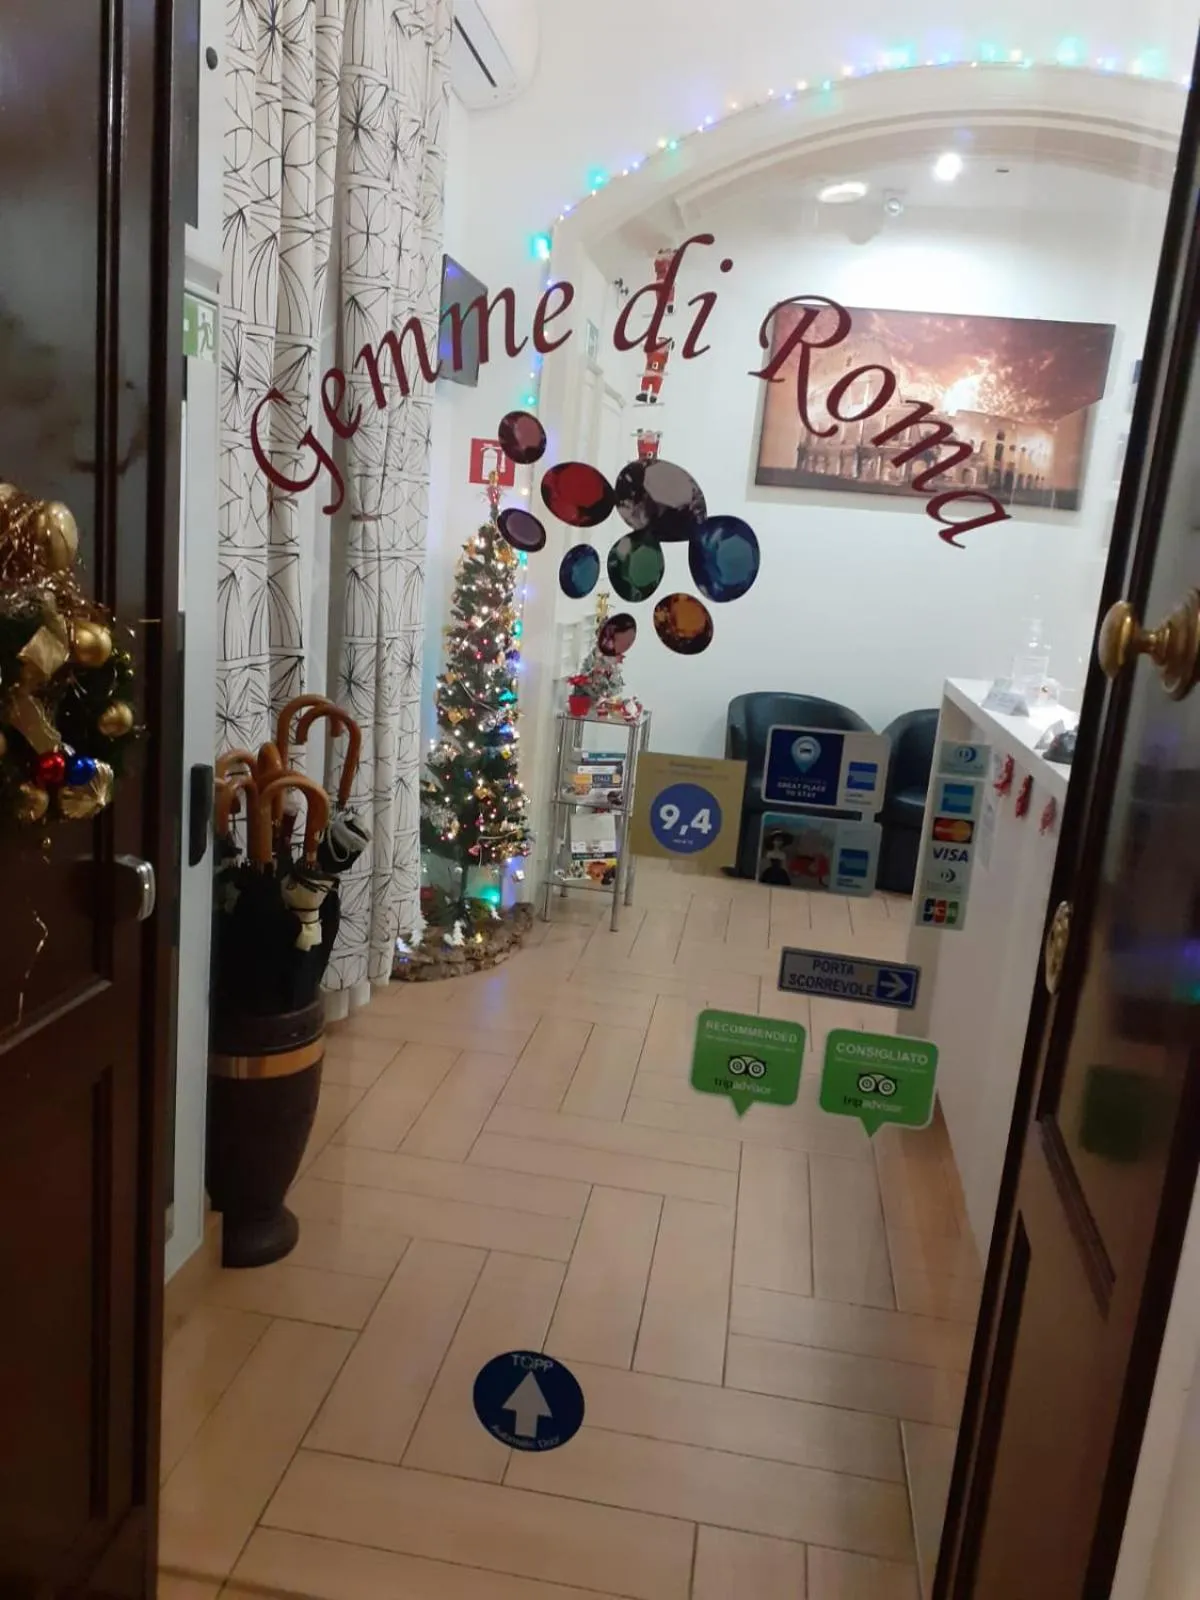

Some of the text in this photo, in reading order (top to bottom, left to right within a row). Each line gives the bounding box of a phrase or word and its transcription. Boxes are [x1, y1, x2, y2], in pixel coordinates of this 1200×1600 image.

[251, 234, 1012, 549] Gemme di Roma
[659, 803, 712, 835] 9,4
[933, 847, 969, 862] VISA
[812, 959, 855, 976] PORTA
[788, 973, 876, 997] SCORREVOLE
[705, 1020, 798, 1043] RECOMMENDED
[836, 1042, 929, 1065] CONSIGLIATO
[511, 1353, 554, 1373] TOPP
